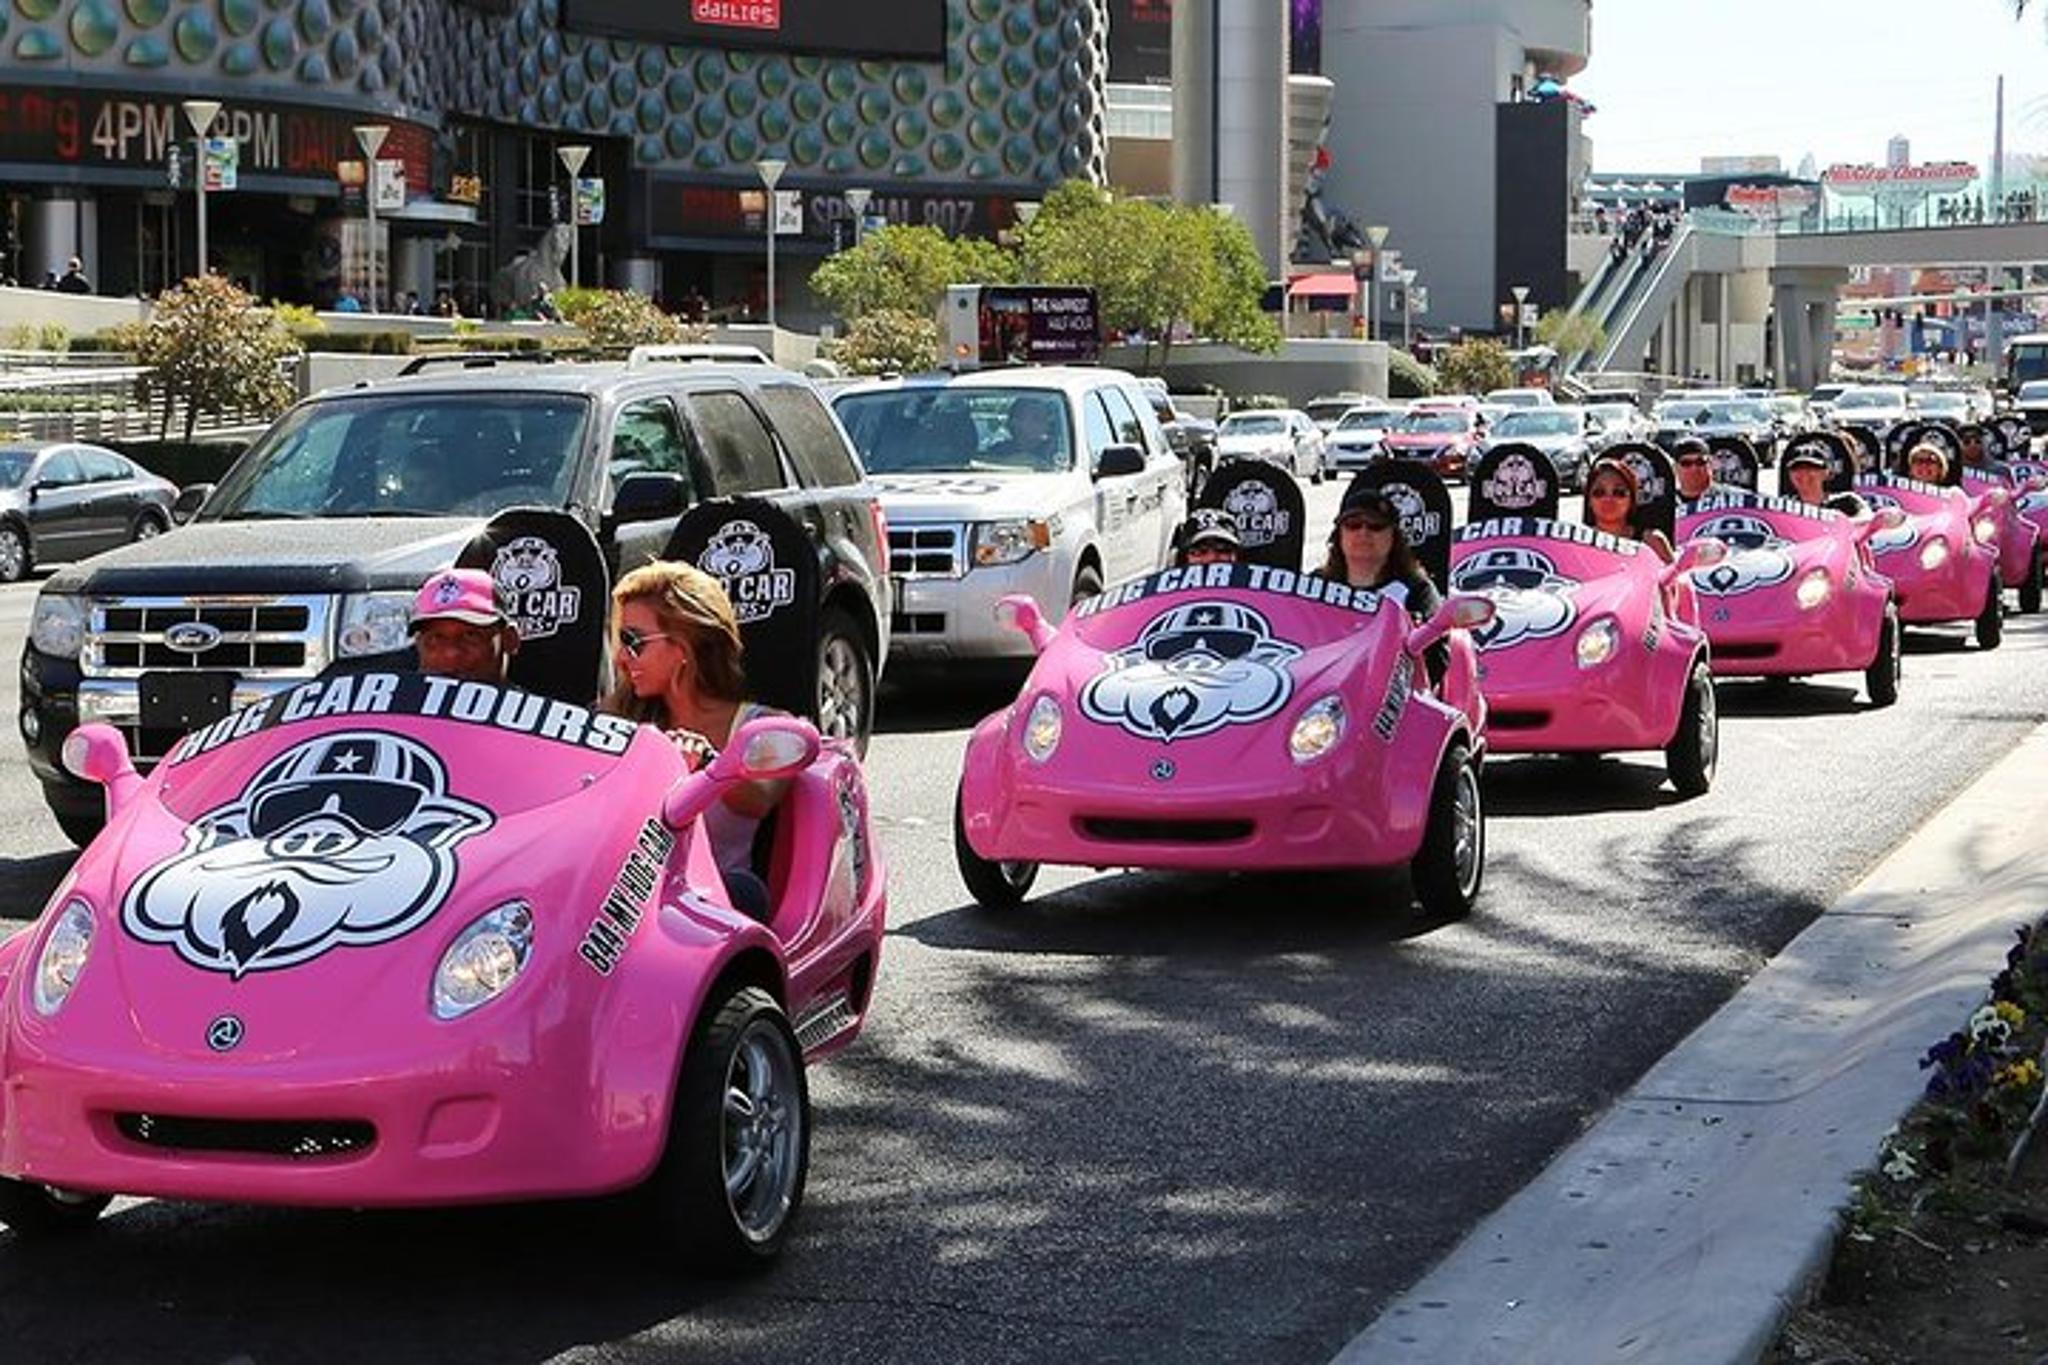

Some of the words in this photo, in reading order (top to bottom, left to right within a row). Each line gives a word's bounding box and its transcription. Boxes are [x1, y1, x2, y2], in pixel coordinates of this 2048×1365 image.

[91, 103, 174, 160] 4PM
[1462, 517, 1523, 541] CAR
[1535, 518, 1640, 556] TOURS
[526, 591, 573, 618] CAR
[739, 574, 789, 601] CAR
[1076, 582, 1146, 618] HOG
[1157, 564, 1232, 594] CAR
[1247, 565, 1380, 614] TOURS
[174, 700, 271, 763] HOG
[281, 673, 399, 723] CAR
[423, 676, 637, 754] TOURS
